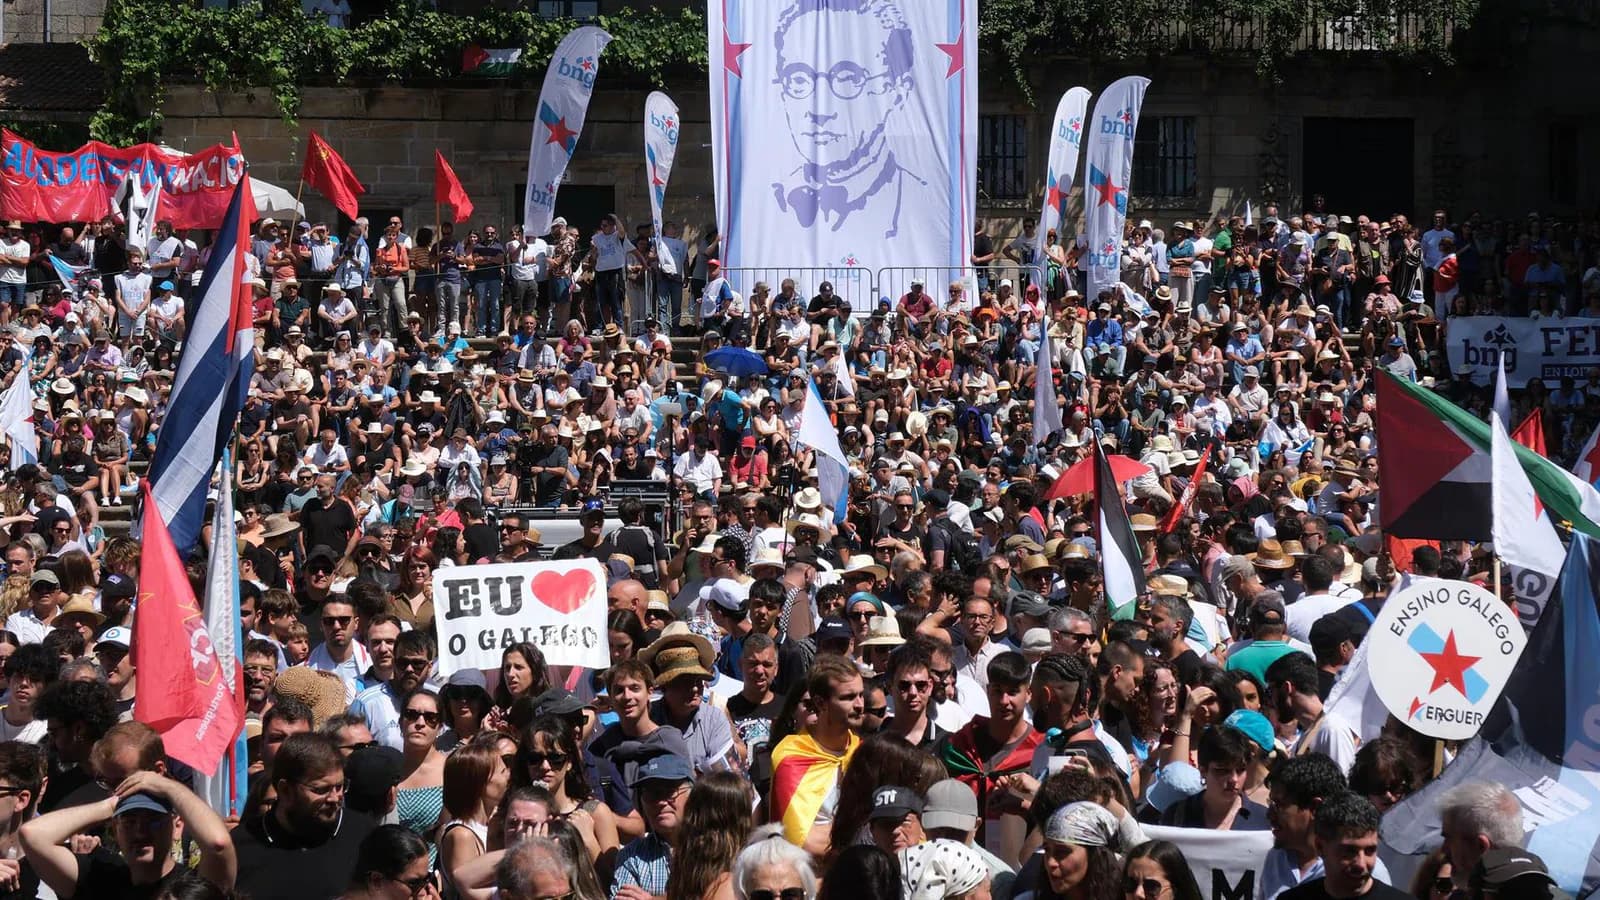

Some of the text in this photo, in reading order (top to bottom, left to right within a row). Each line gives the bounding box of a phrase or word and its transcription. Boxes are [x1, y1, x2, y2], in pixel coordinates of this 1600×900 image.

[558, 57, 595, 89] bng
[650, 110, 678, 145] bng
[1100, 115, 1134, 141] bng
[1088, 251, 1119, 270] bng
[1462, 338, 1517, 374] bng
[1544, 367, 1561, 377] EN
[443, 575, 525, 620] EU
[1389, 588, 1514, 656] ENSINO GALEGO
[449, 624, 599, 656] O GALEGO
[1426, 706, 1485, 726] ERGUER
